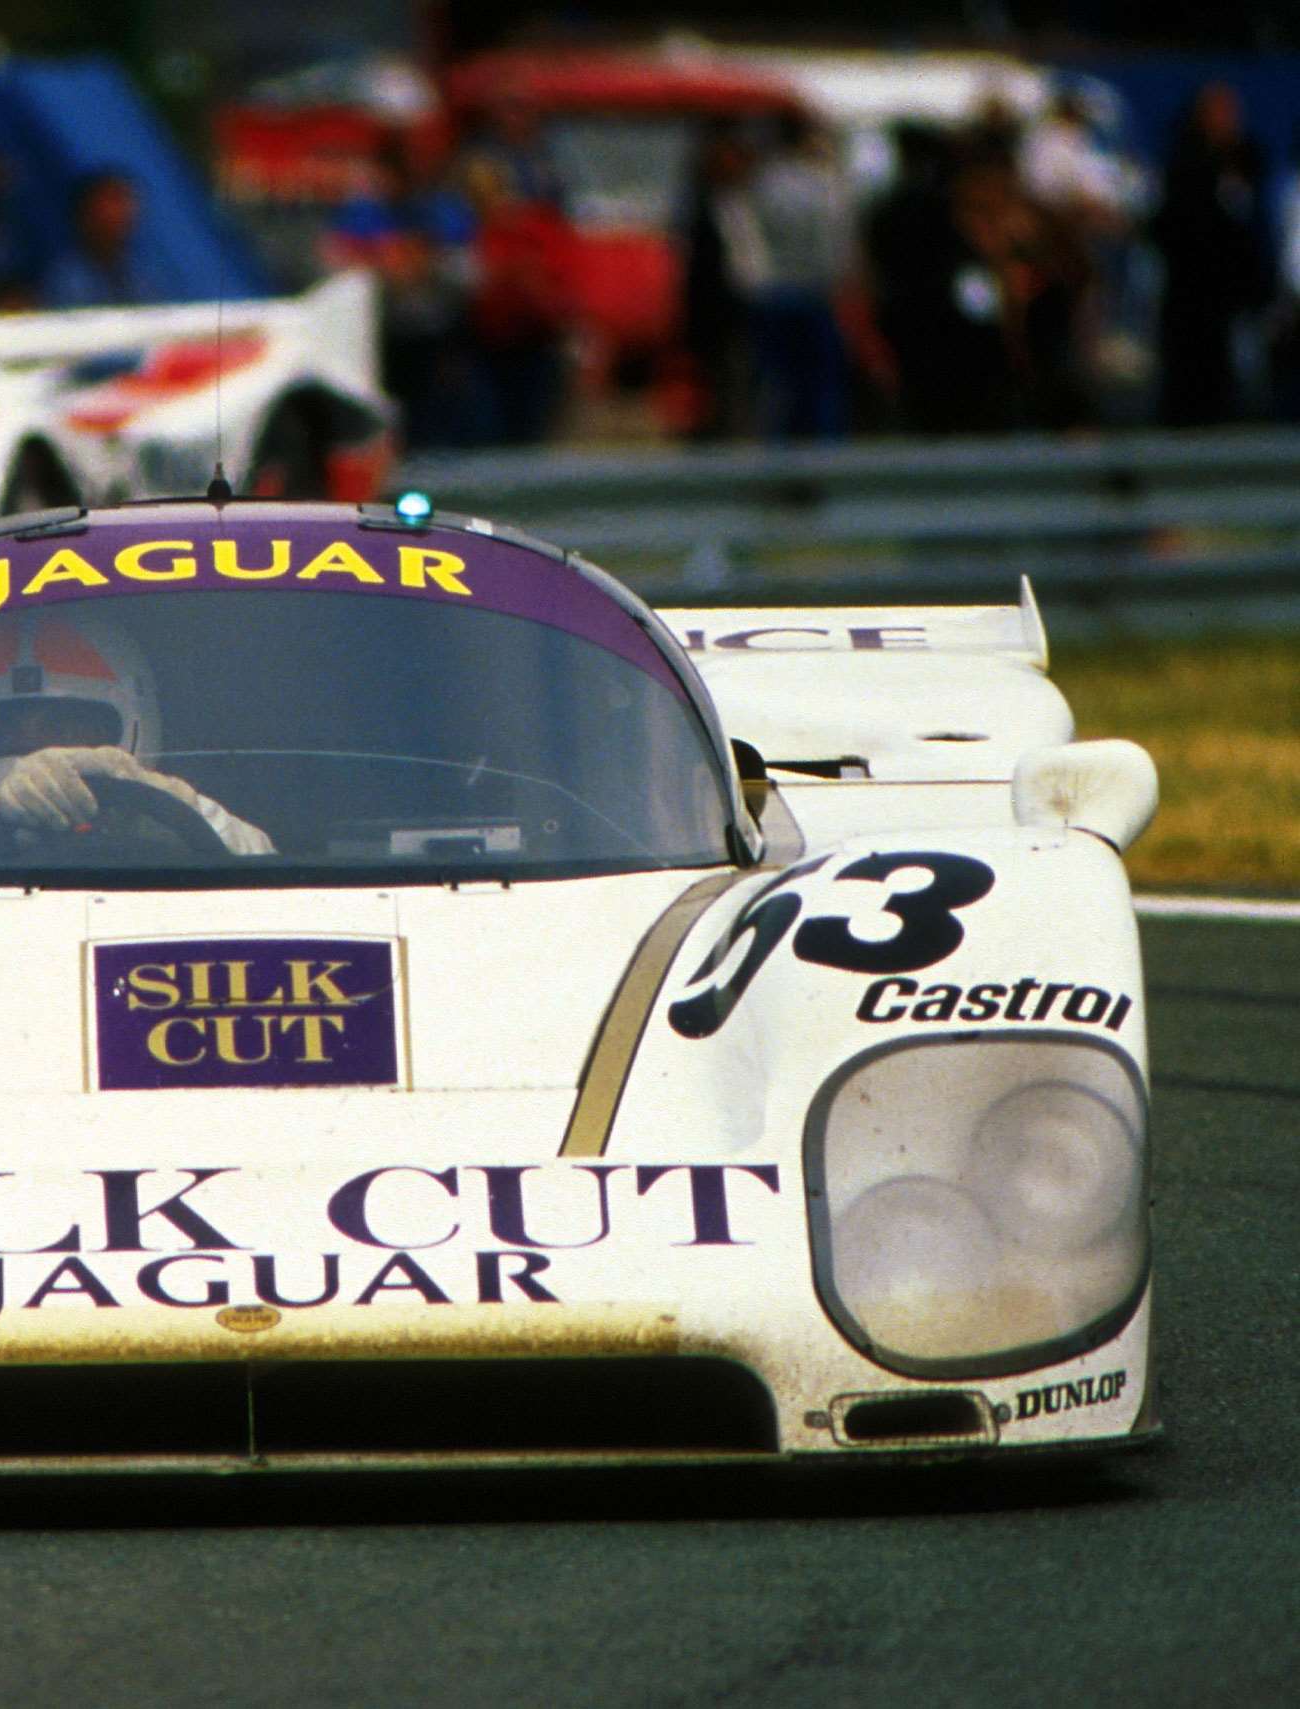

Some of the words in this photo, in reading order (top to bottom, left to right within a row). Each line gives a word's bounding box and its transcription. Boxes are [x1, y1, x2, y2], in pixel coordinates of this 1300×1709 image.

[128, 960, 359, 1010] SILK
[855, 976, 1132, 1033] Castrol
[147, 1014, 345, 1066] CUT
[326, 1163, 781, 1249] CUT
[1015, 1369, 1127, 1421] DUNLOP
